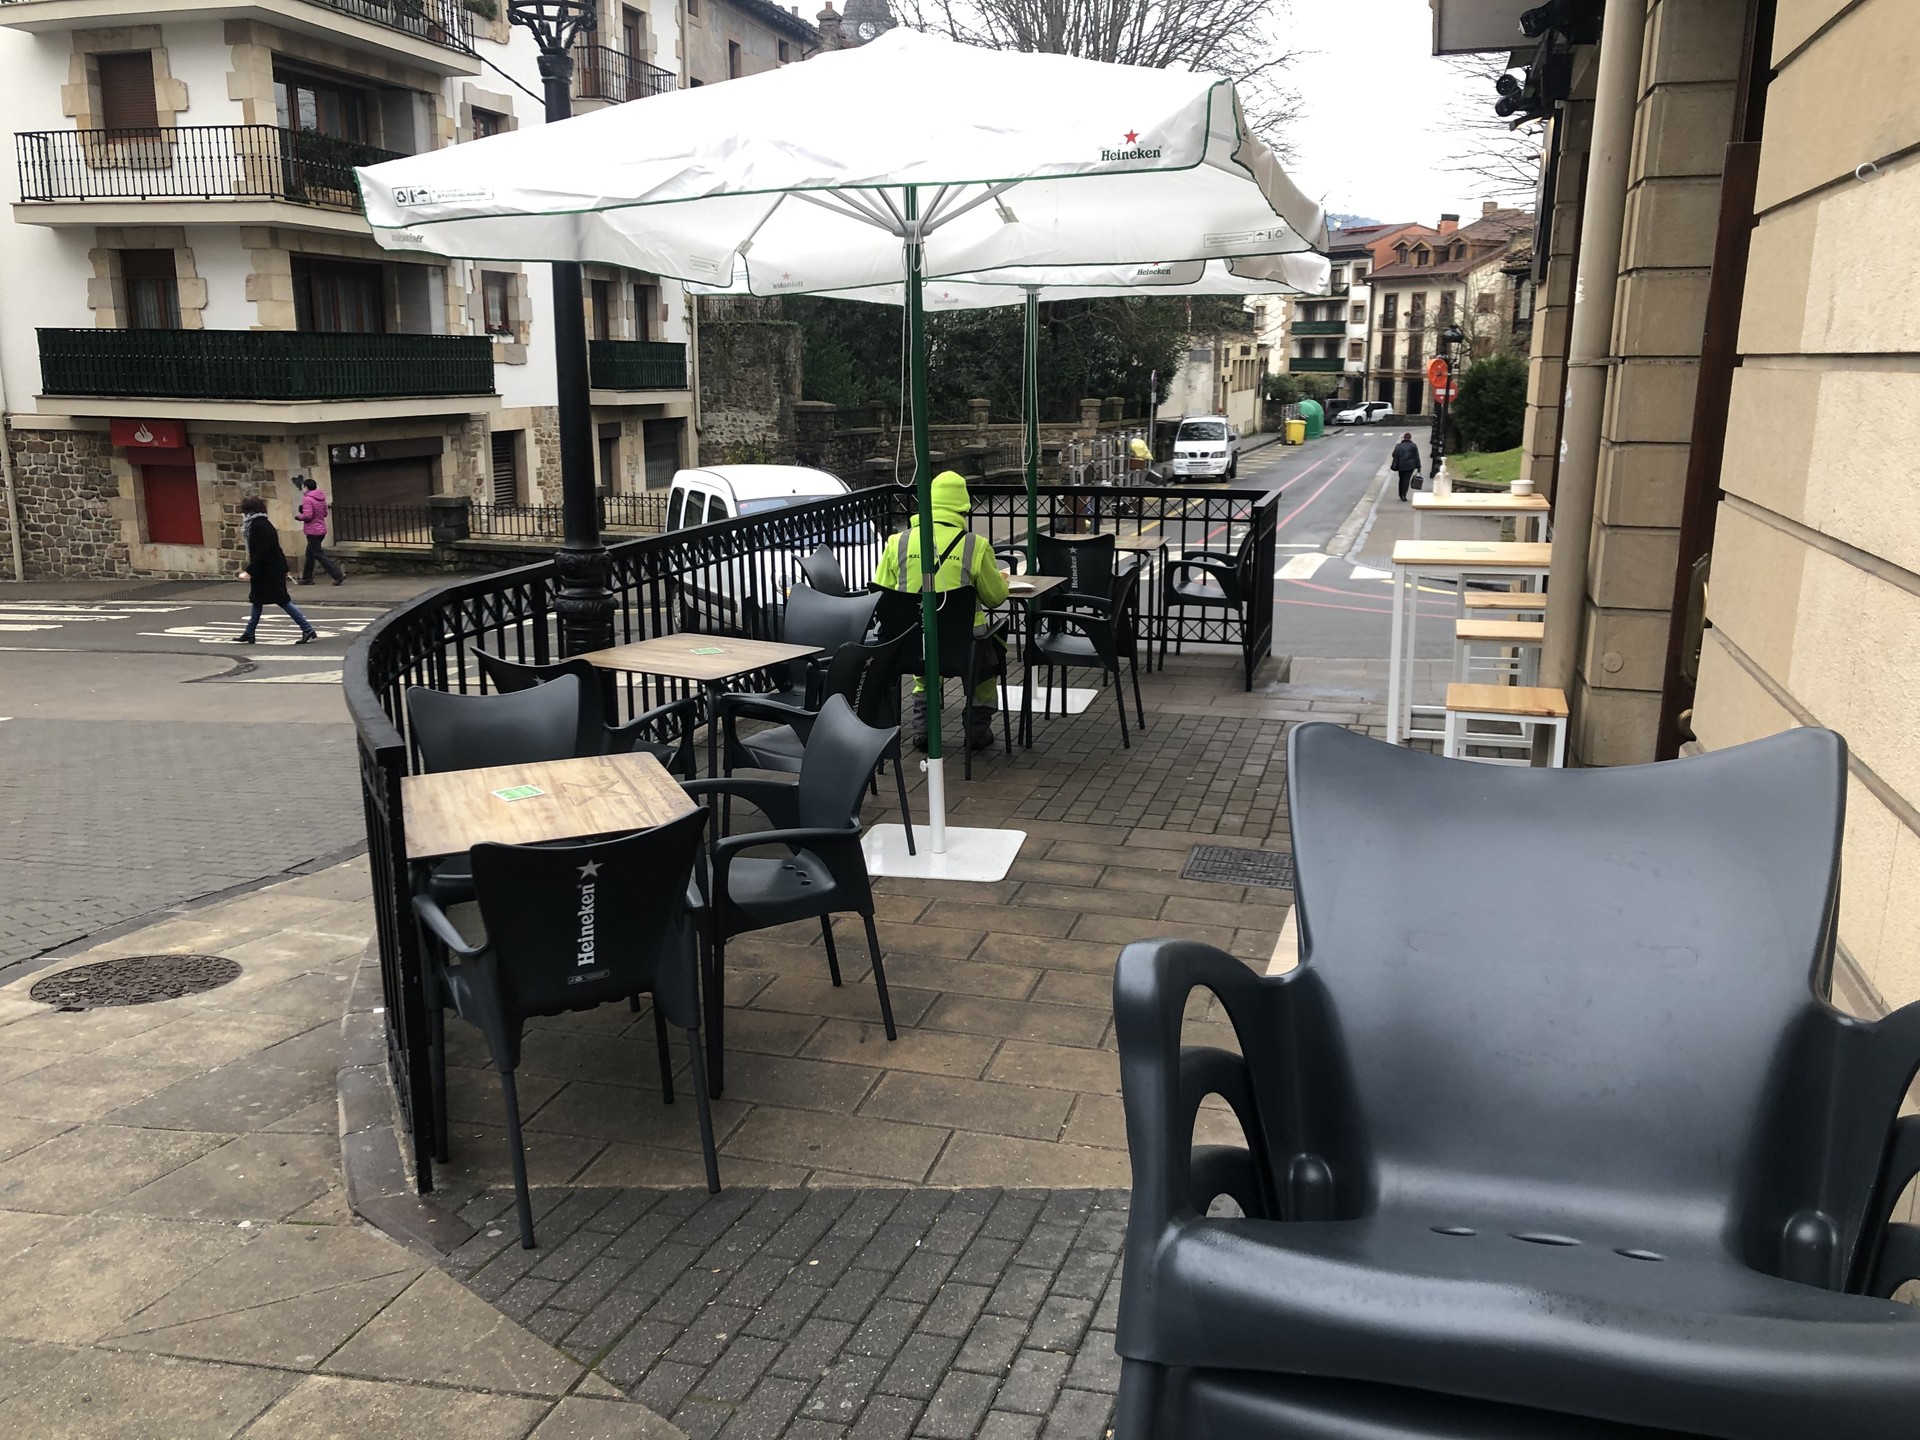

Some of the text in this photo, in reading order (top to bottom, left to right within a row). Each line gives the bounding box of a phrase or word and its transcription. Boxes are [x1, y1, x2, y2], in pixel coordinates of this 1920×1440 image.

[1101, 147, 1161, 161] Heineken
[1070, 555, 1079, 589] Heineken
[853, 671, 867, 715] eineken
[577, 882, 596, 967] Heineken
